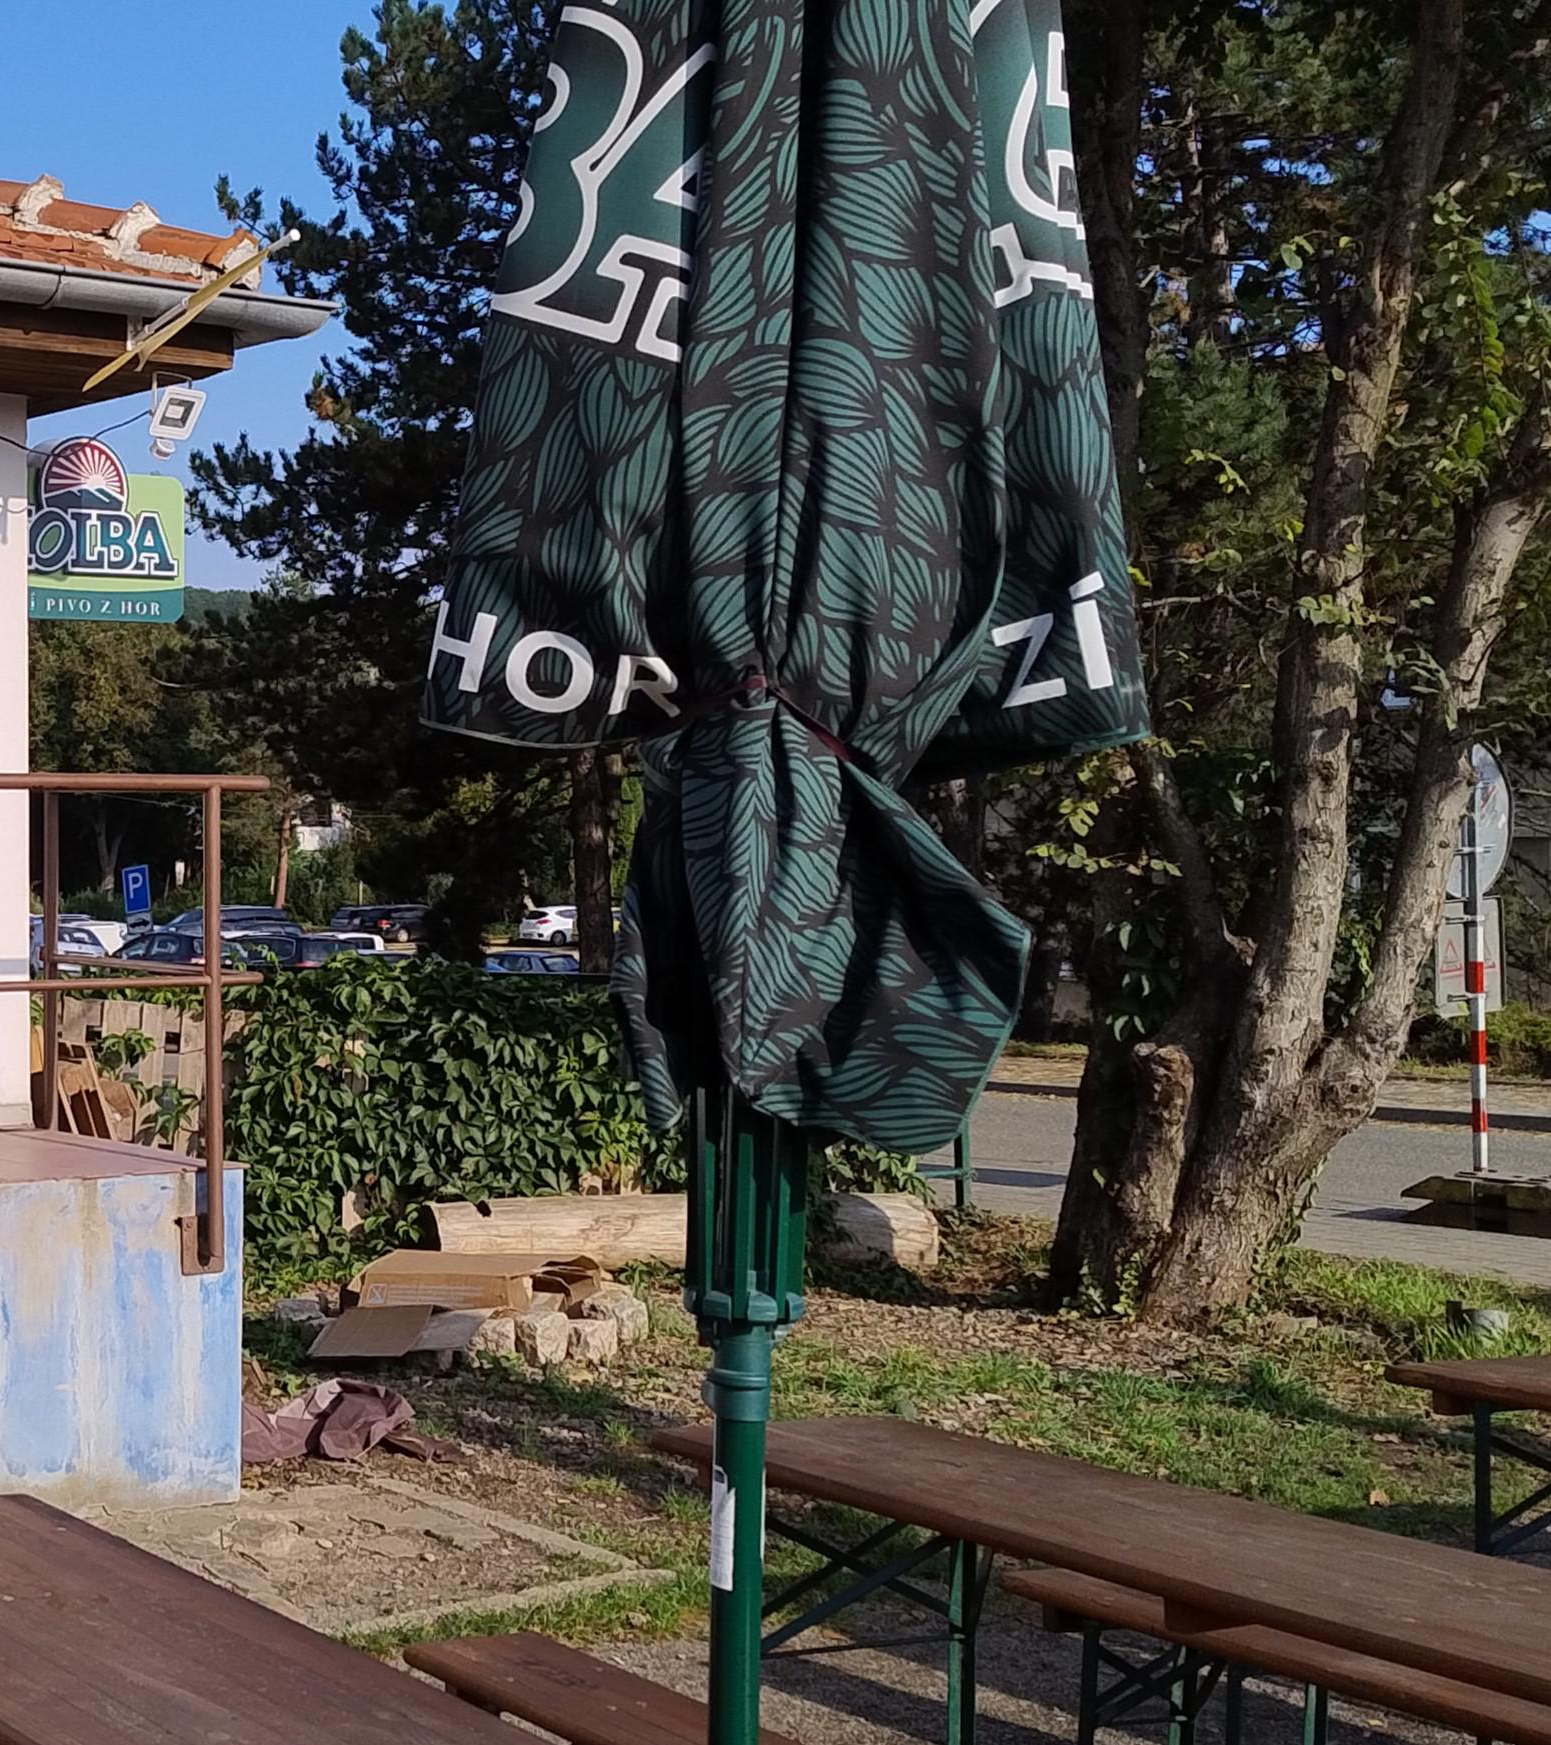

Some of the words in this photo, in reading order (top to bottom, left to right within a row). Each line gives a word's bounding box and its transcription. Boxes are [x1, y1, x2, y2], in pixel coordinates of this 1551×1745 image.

[28, 506, 179, 577] OLBA
[46, 598, 92, 613] PIVO
[100, 600, 113, 614] Z
[120, 601, 161, 616] HOR
[128, 872, 143, 899] P
